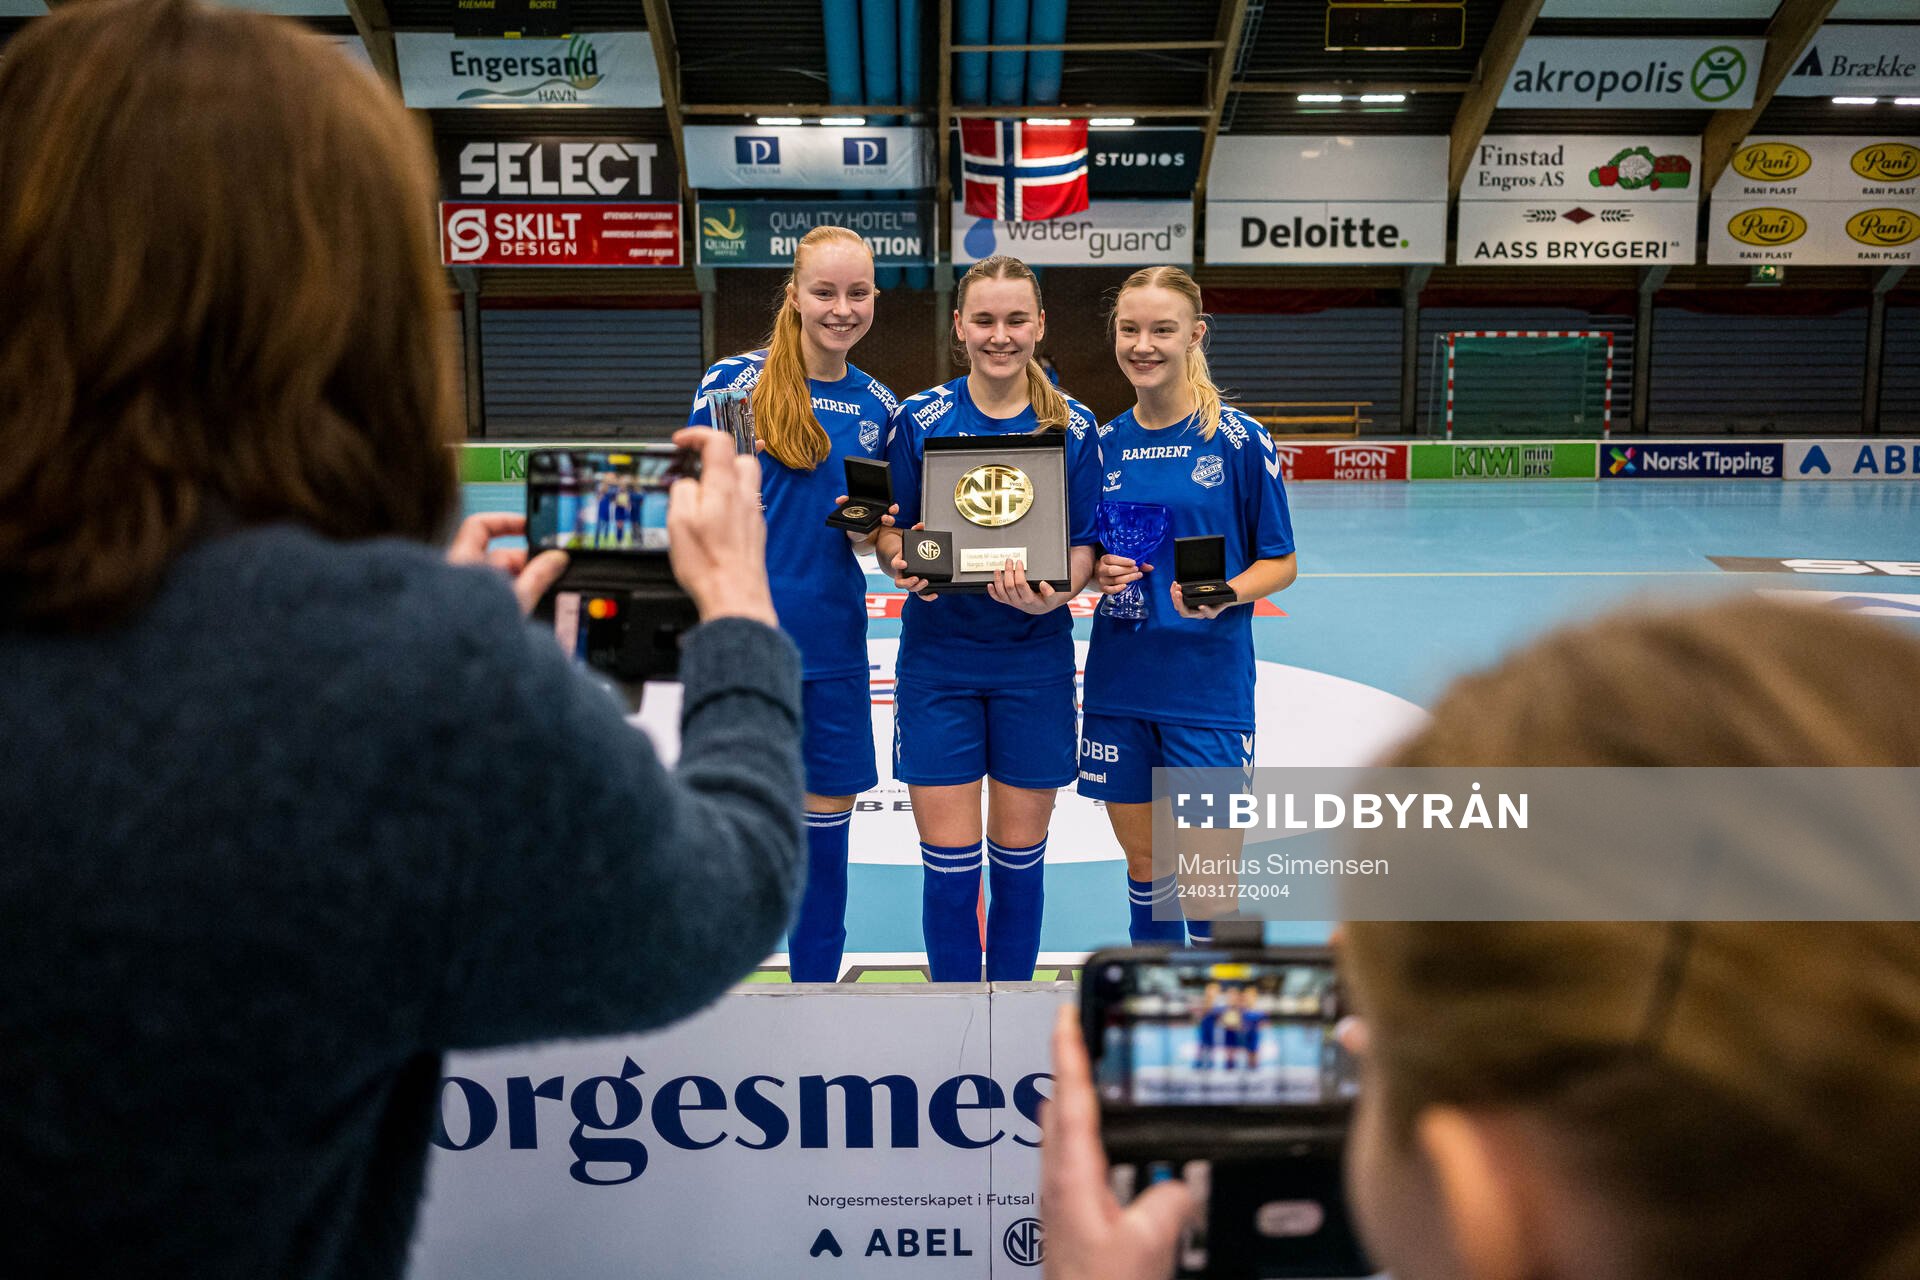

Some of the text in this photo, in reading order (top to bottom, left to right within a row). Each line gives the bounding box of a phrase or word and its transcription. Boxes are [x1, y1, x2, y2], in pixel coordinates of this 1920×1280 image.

[451, 50, 597, 82] Engersand
[1830, 55, 1917, 77] Brække
[1513, 61, 1684, 101] akropolis
[538, 90, 578, 102] HAVN
[1095, 153, 1185, 166] STUDIOS
[1480, 145, 1564, 166] Finstad
[459, 143, 658, 195] SELECT
[1479, 172, 1565, 191] Engros AS
[1744, 187, 1798, 195] RANI PLAST
[494, 213, 581, 241] SKILT
[769, 212, 843, 233] QUALITY
[500, 242, 577, 256] DESIGN
[1474, 241, 1537, 258] AASS
[1547, 241, 1667, 258] BRYGGERI
[810, 397, 861, 416] MIRENT
[912, 395, 945, 423] happy
[919, 401, 953, 430] homes
[1069, 408, 1090, 430] appy
[1224, 412, 1249, 439] happy
[1122, 445, 1192, 461] RAMIRENT
[1329, 447, 1391, 467] THON
[1454, 447, 1520, 477] KIWI
[1524, 447, 1553, 461] mini
[1643, 451, 1775, 474] Norsk Tipping
[1334, 469, 1386, 479] HOTELS
[1524, 463, 1550, 477] pris
[1081, 738, 1119, 763] OBB
[432, 1055, 1053, 1186] orgesmes
[808, 1192, 1035, 1209] Norgesmesterskapet i Futsal
[865, 1228, 973, 1257] ABEL
